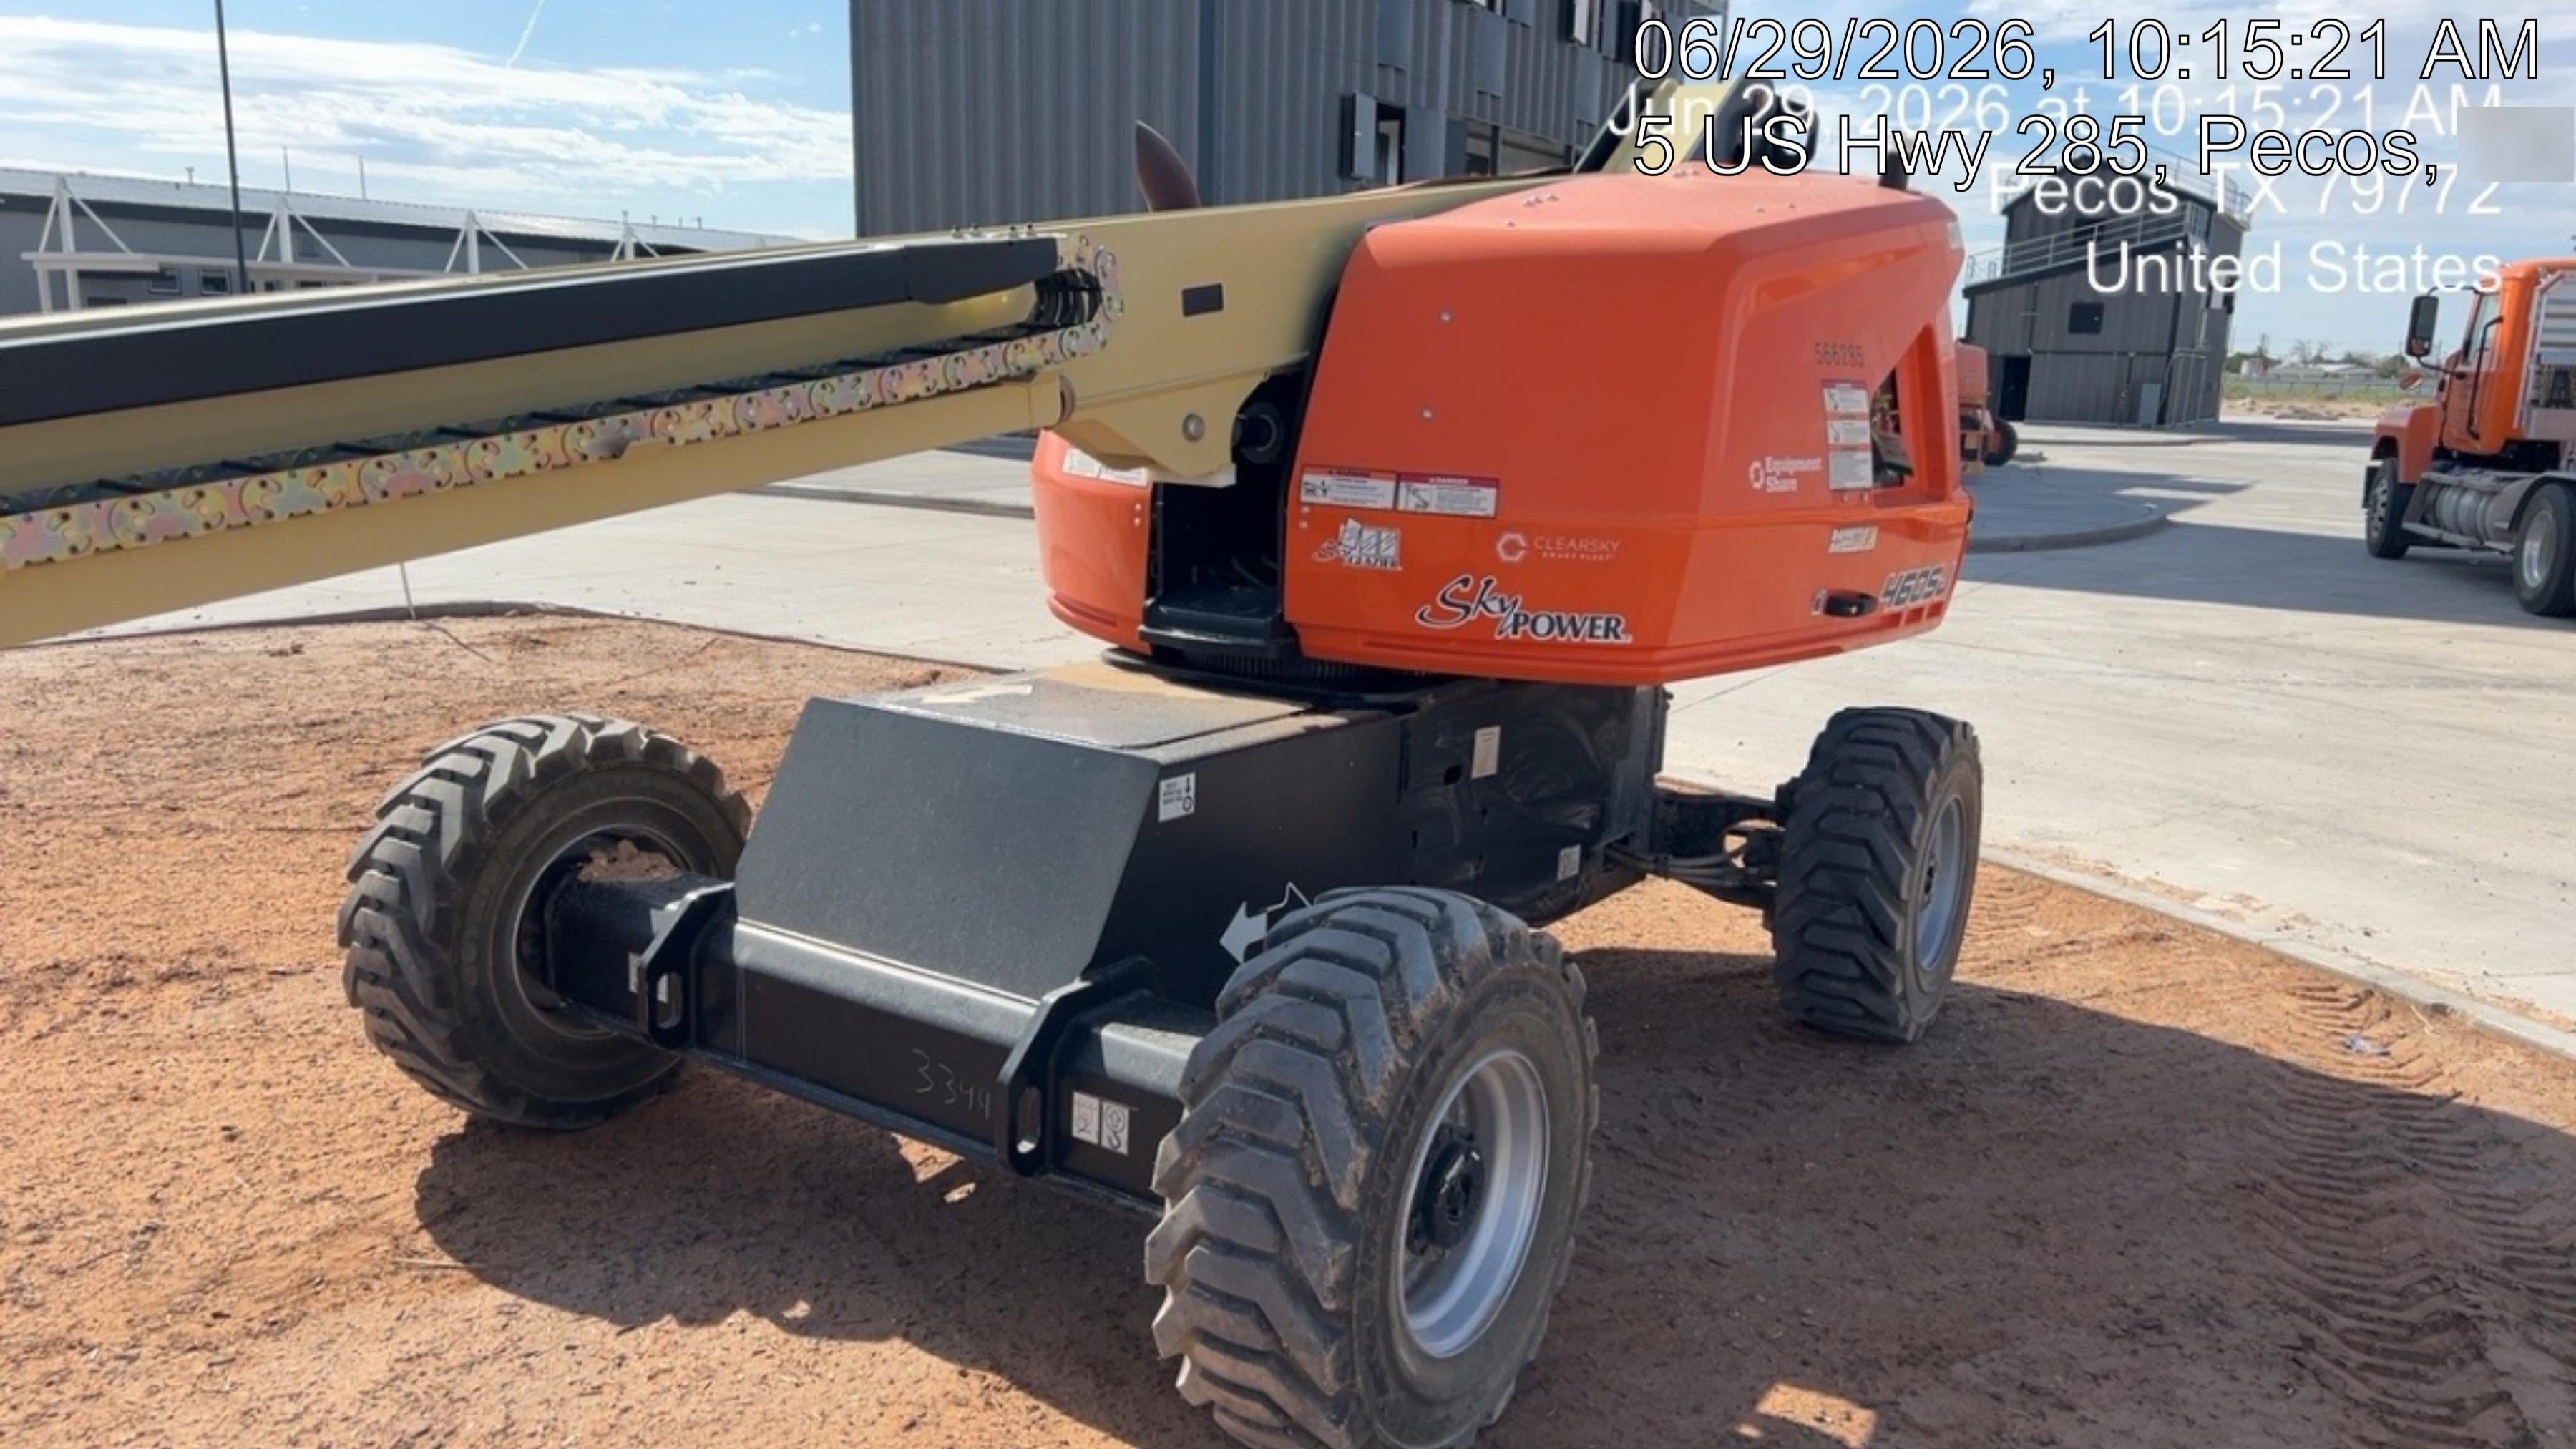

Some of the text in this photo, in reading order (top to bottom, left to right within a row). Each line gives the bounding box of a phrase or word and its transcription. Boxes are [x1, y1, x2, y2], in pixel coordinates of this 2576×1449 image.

[1533, 535, 1621, 552] CLEARSKY
[1415, 574, 1624, 641] Sky POWER
